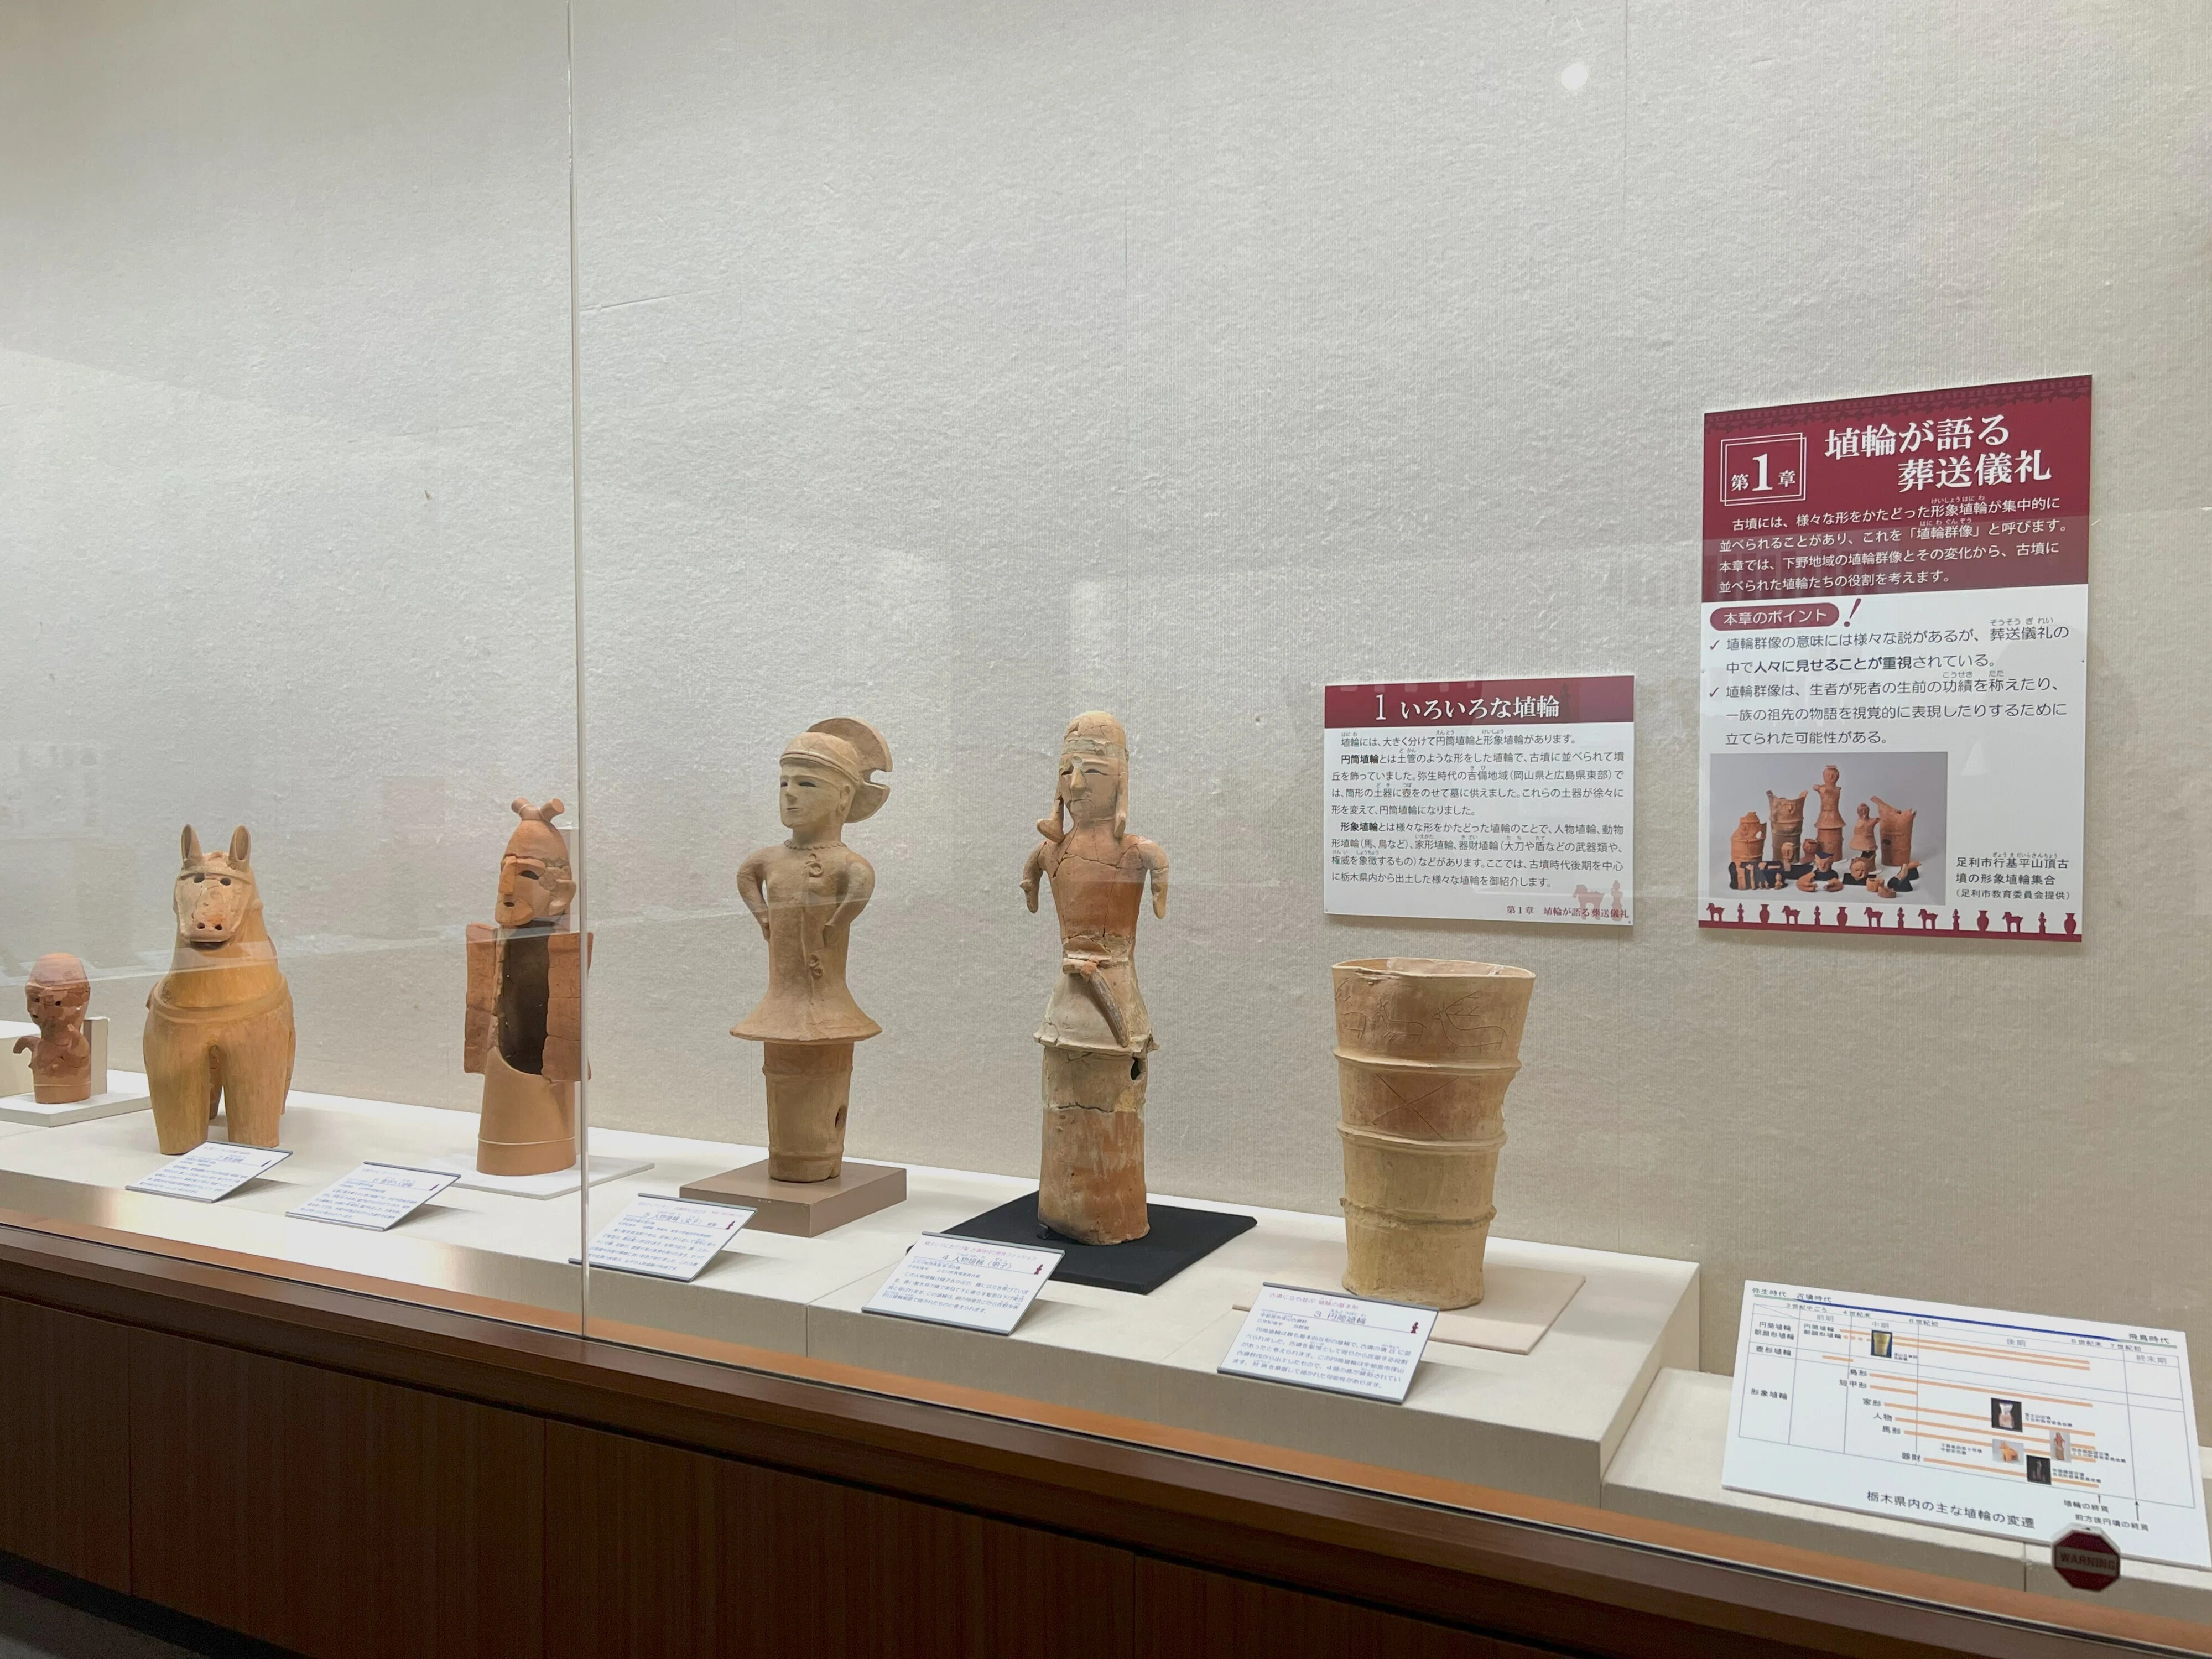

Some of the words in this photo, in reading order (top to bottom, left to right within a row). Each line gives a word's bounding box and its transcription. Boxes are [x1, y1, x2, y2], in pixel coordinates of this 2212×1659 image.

[1824, 414, 2010, 460] 埴輪が語る
[1731, 453, 1796, 492] 第1章
[1897, 450, 2052, 492] 葬送儀礼
[1732, 497, 2060, 531] 古墳には、様々な形をかたどった形象埴輪が集中的に
[1720, 519, 2066, 552] 並べられることがあり、これを「埴輪群像」と呼びます。
[1719, 542, 2059, 573] 本章では、下野地域の埴輪群像とその変化から、古墳に
[1719, 569, 1950, 593] 並べられた埴輪たちの役割を考えます。
[1724, 609, 1826, 626] 本章のポイント
[1726, 626, 2069, 651] 埴輪群像の意味には様々な説があるが、葬送儀礼の
[1726, 654, 1995, 673] 中で人々に見せることが重視されている。
[1726, 677, 2059, 698] 埴輪群像は、生者が死者の生前の功績を称えたり、
[1376, 694, 1387, 720] 1
[1401, 695, 1560, 720] いろいろな埴輪
[1726, 703, 2067, 721] 一族の祖先の物語を視覚的に表現したりするために
[1341, 734, 1576, 747] 埴輪には、大きく分けて円筒埴輪と形象埴輪があります。
[1726, 731, 1887, 745] 立てられた可能性がある。
[1341, 751, 1624, 765] 円筒埴輪とは土管のような形をした埴輪で、古墳に並べられて墳
[1331, 804, 1475, 817] 形を変えて、円筒埴輪になりました。
[1340, 821, 1624, 835] 形象埴輪とは様々な形をかたどった埴輪のことで、人物埴輪、動物
[1331, 855, 1624, 871] 権威を象徴するもの）などがあります。ここでは、古墳時代後期を中心
[1956, 857, 2069, 869] 足利市行基平山頂古
[1332, 872, 1551, 888] に栃木県内から出土した様々な埴輪を御紹介します。
[1956, 873, 2055, 885] 墳の形象埴輪集合
[1956, 888, 2070, 901] （足利市教育委員会提供）
[1867, 1490, 2036, 1529] 栃木県内の主な埴輪の変遷
[2060, 1552, 2116, 1570] WARNING
